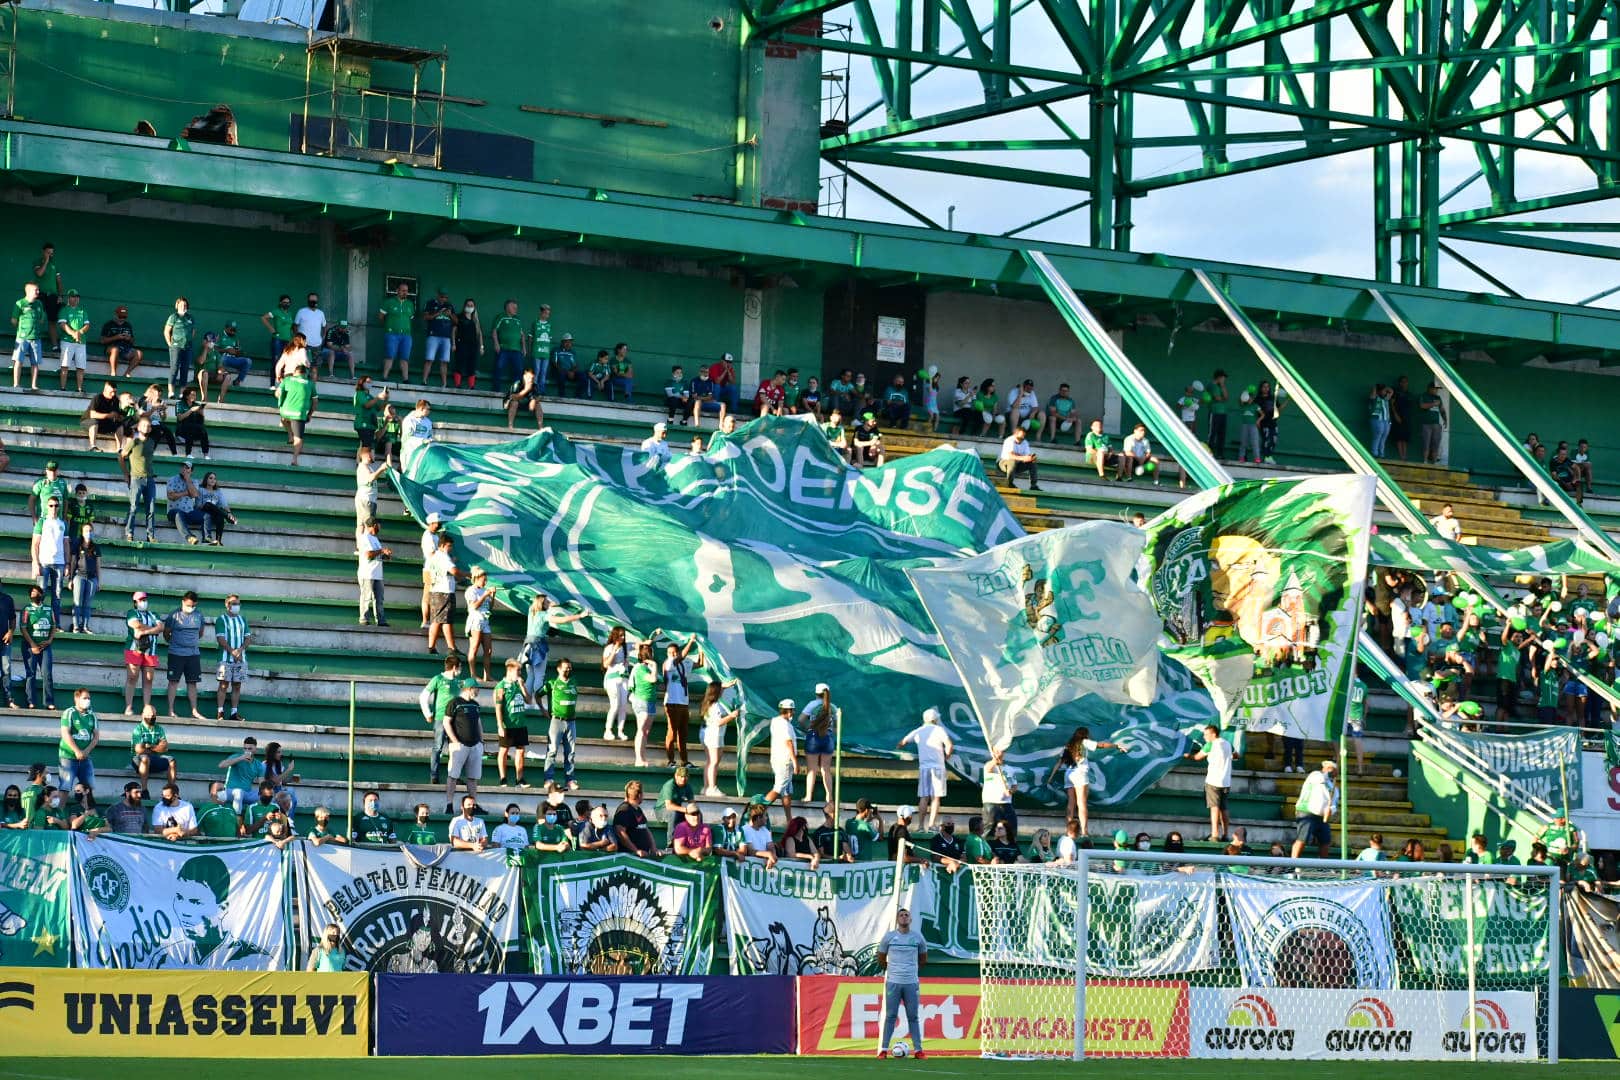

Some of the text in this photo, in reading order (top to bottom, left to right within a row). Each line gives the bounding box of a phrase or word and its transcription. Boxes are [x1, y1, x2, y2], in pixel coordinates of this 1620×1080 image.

[324, 862, 509, 923] PELOTÃO FEMININO
[739, 860, 834, 901] TORCIDA
[1278, 905, 1316, 928] JOVEM
[345, 907, 420, 972] ORCID
[64, 993, 358, 1035] UNIASSELVI
[478, 981, 705, 1045] 1XBET
[1204, 1027, 1296, 1051] aurora
[1325, 1029, 1413, 1053] aurora
